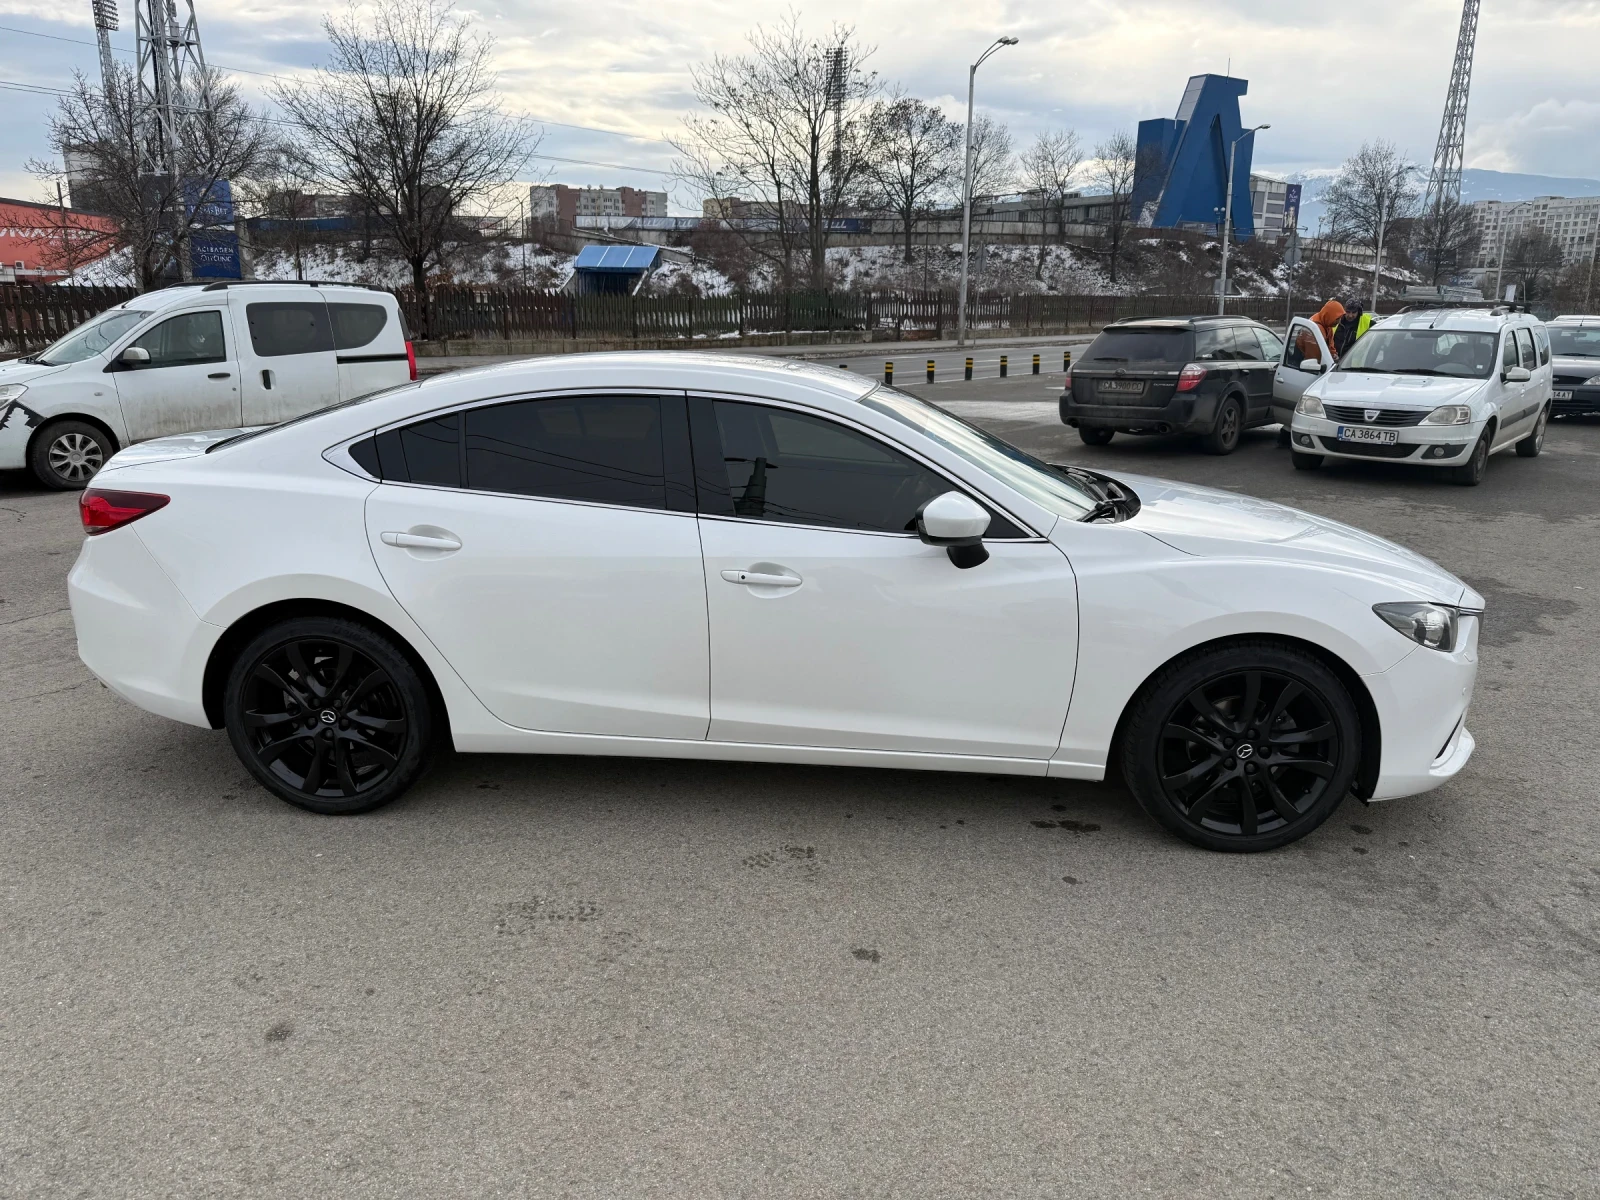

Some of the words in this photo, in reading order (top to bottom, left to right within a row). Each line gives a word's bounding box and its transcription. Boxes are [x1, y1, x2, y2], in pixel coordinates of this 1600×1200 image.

[1344, 428, 1356, 438] CA
[1358, 429, 1381, 440] 3864
[1383, 431, 1396, 441] TB
